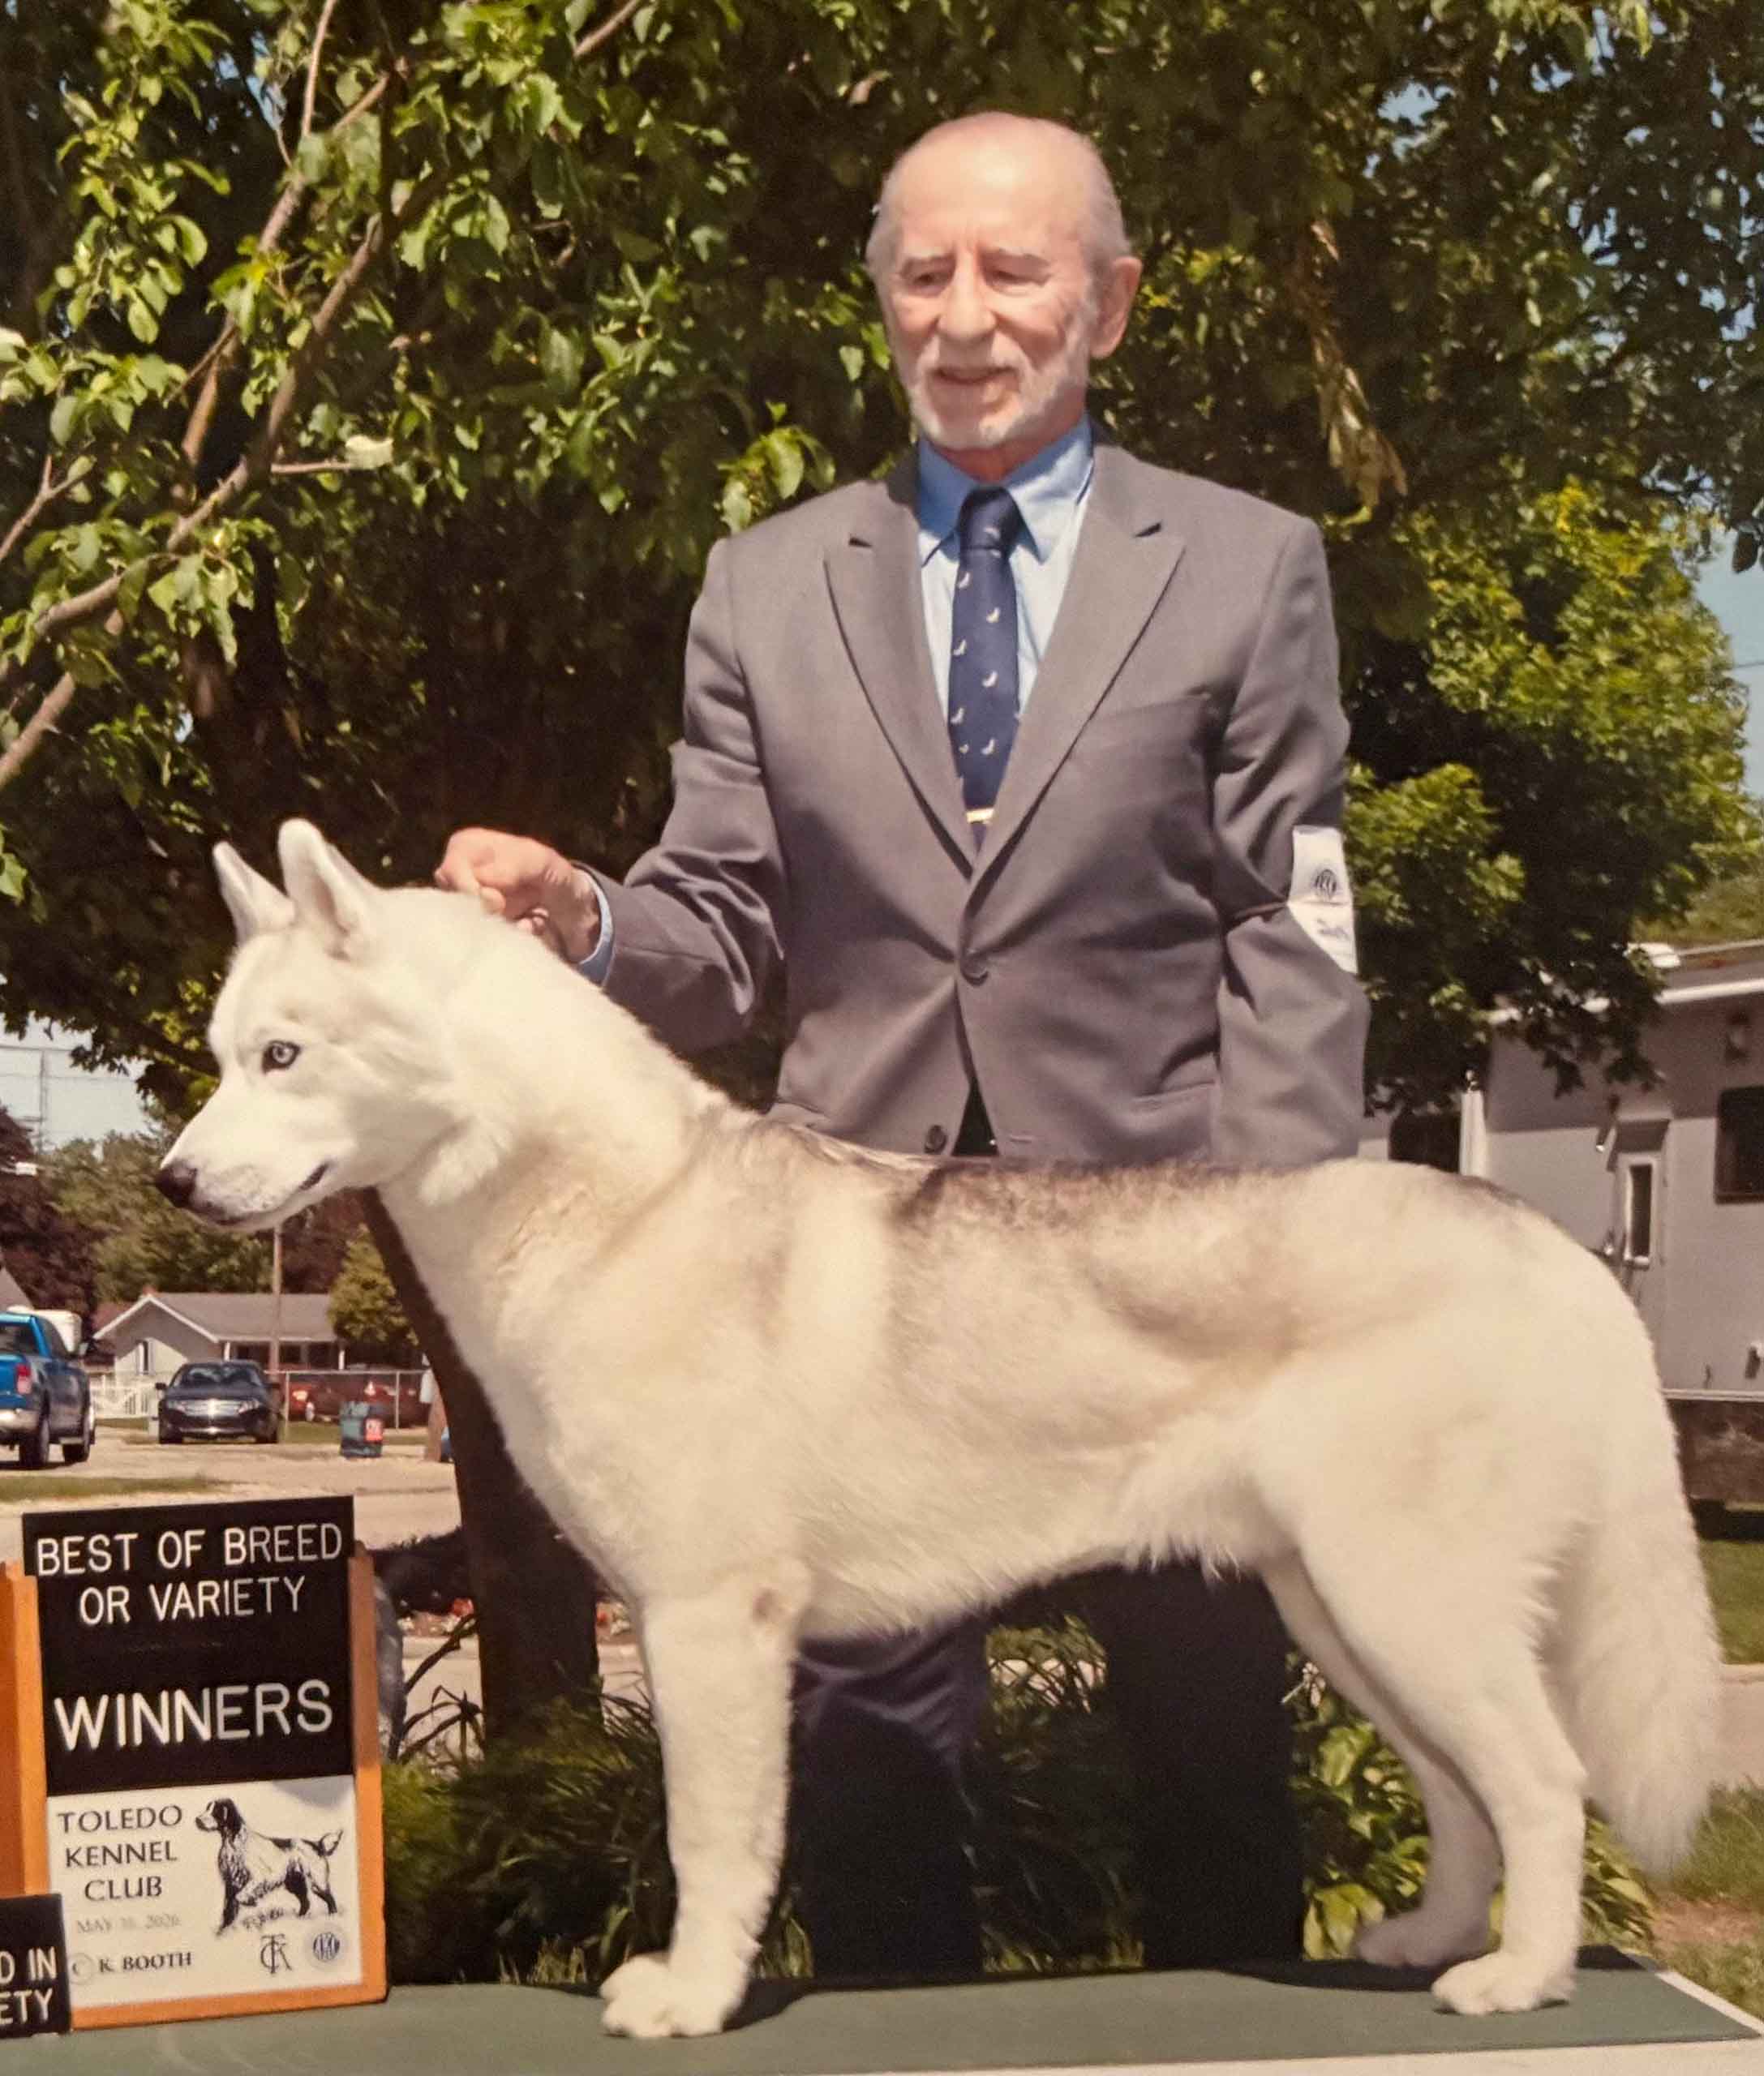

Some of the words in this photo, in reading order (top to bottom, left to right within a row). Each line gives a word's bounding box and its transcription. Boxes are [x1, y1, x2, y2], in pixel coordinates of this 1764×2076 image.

[37, 1533, 139, 1576] BEST
[157, 1529, 206, 1569] OF
[224, 1523, 341, 1565] BREED
[80, 1585, 131, 1625] OR
[148, 1576, 306, 1621] VARIETY
[54, 1679, 333, 1751] WINNERS
[58, 1805, 182, 1834] TOLEDO
[65, 1841, 178, 1868] KENNEL
[84, 1876, 163, 1901] CLUB
[76, 1917, 112, 1933] MAY
[28, 1946, 57, 1981] IN
[122, 1952, 192, 1971] BOOTH
